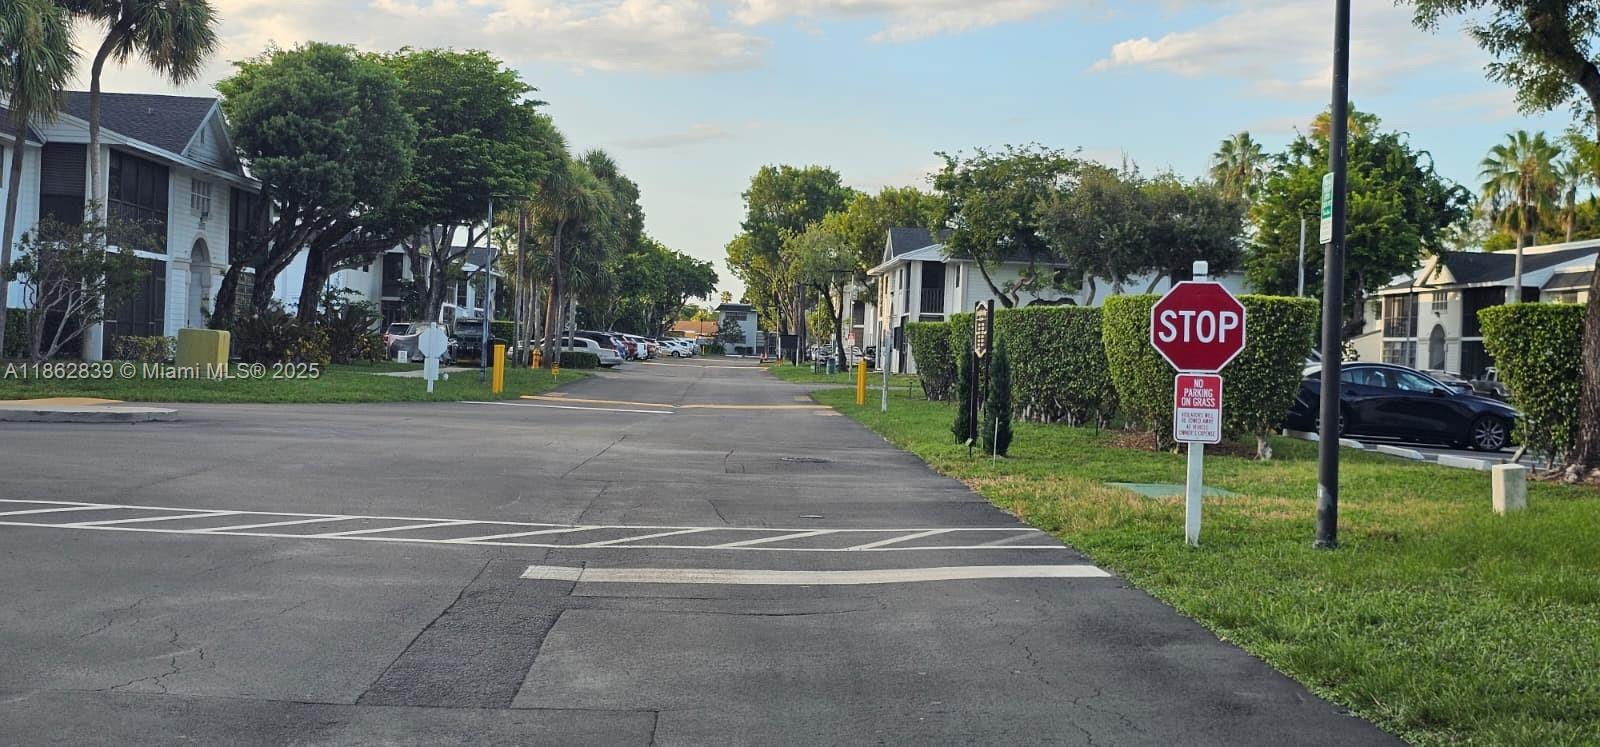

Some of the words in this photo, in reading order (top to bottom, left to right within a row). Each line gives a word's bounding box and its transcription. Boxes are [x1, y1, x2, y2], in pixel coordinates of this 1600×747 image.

[1158, 309, 1239, 344] STOP
[1193, 378, 1204, 388] NO
[1183, 387, 1214, 398] PARKING
[1181, 397, 1191, 407] ON
[1192, 397, 1216, 408] GRASS
